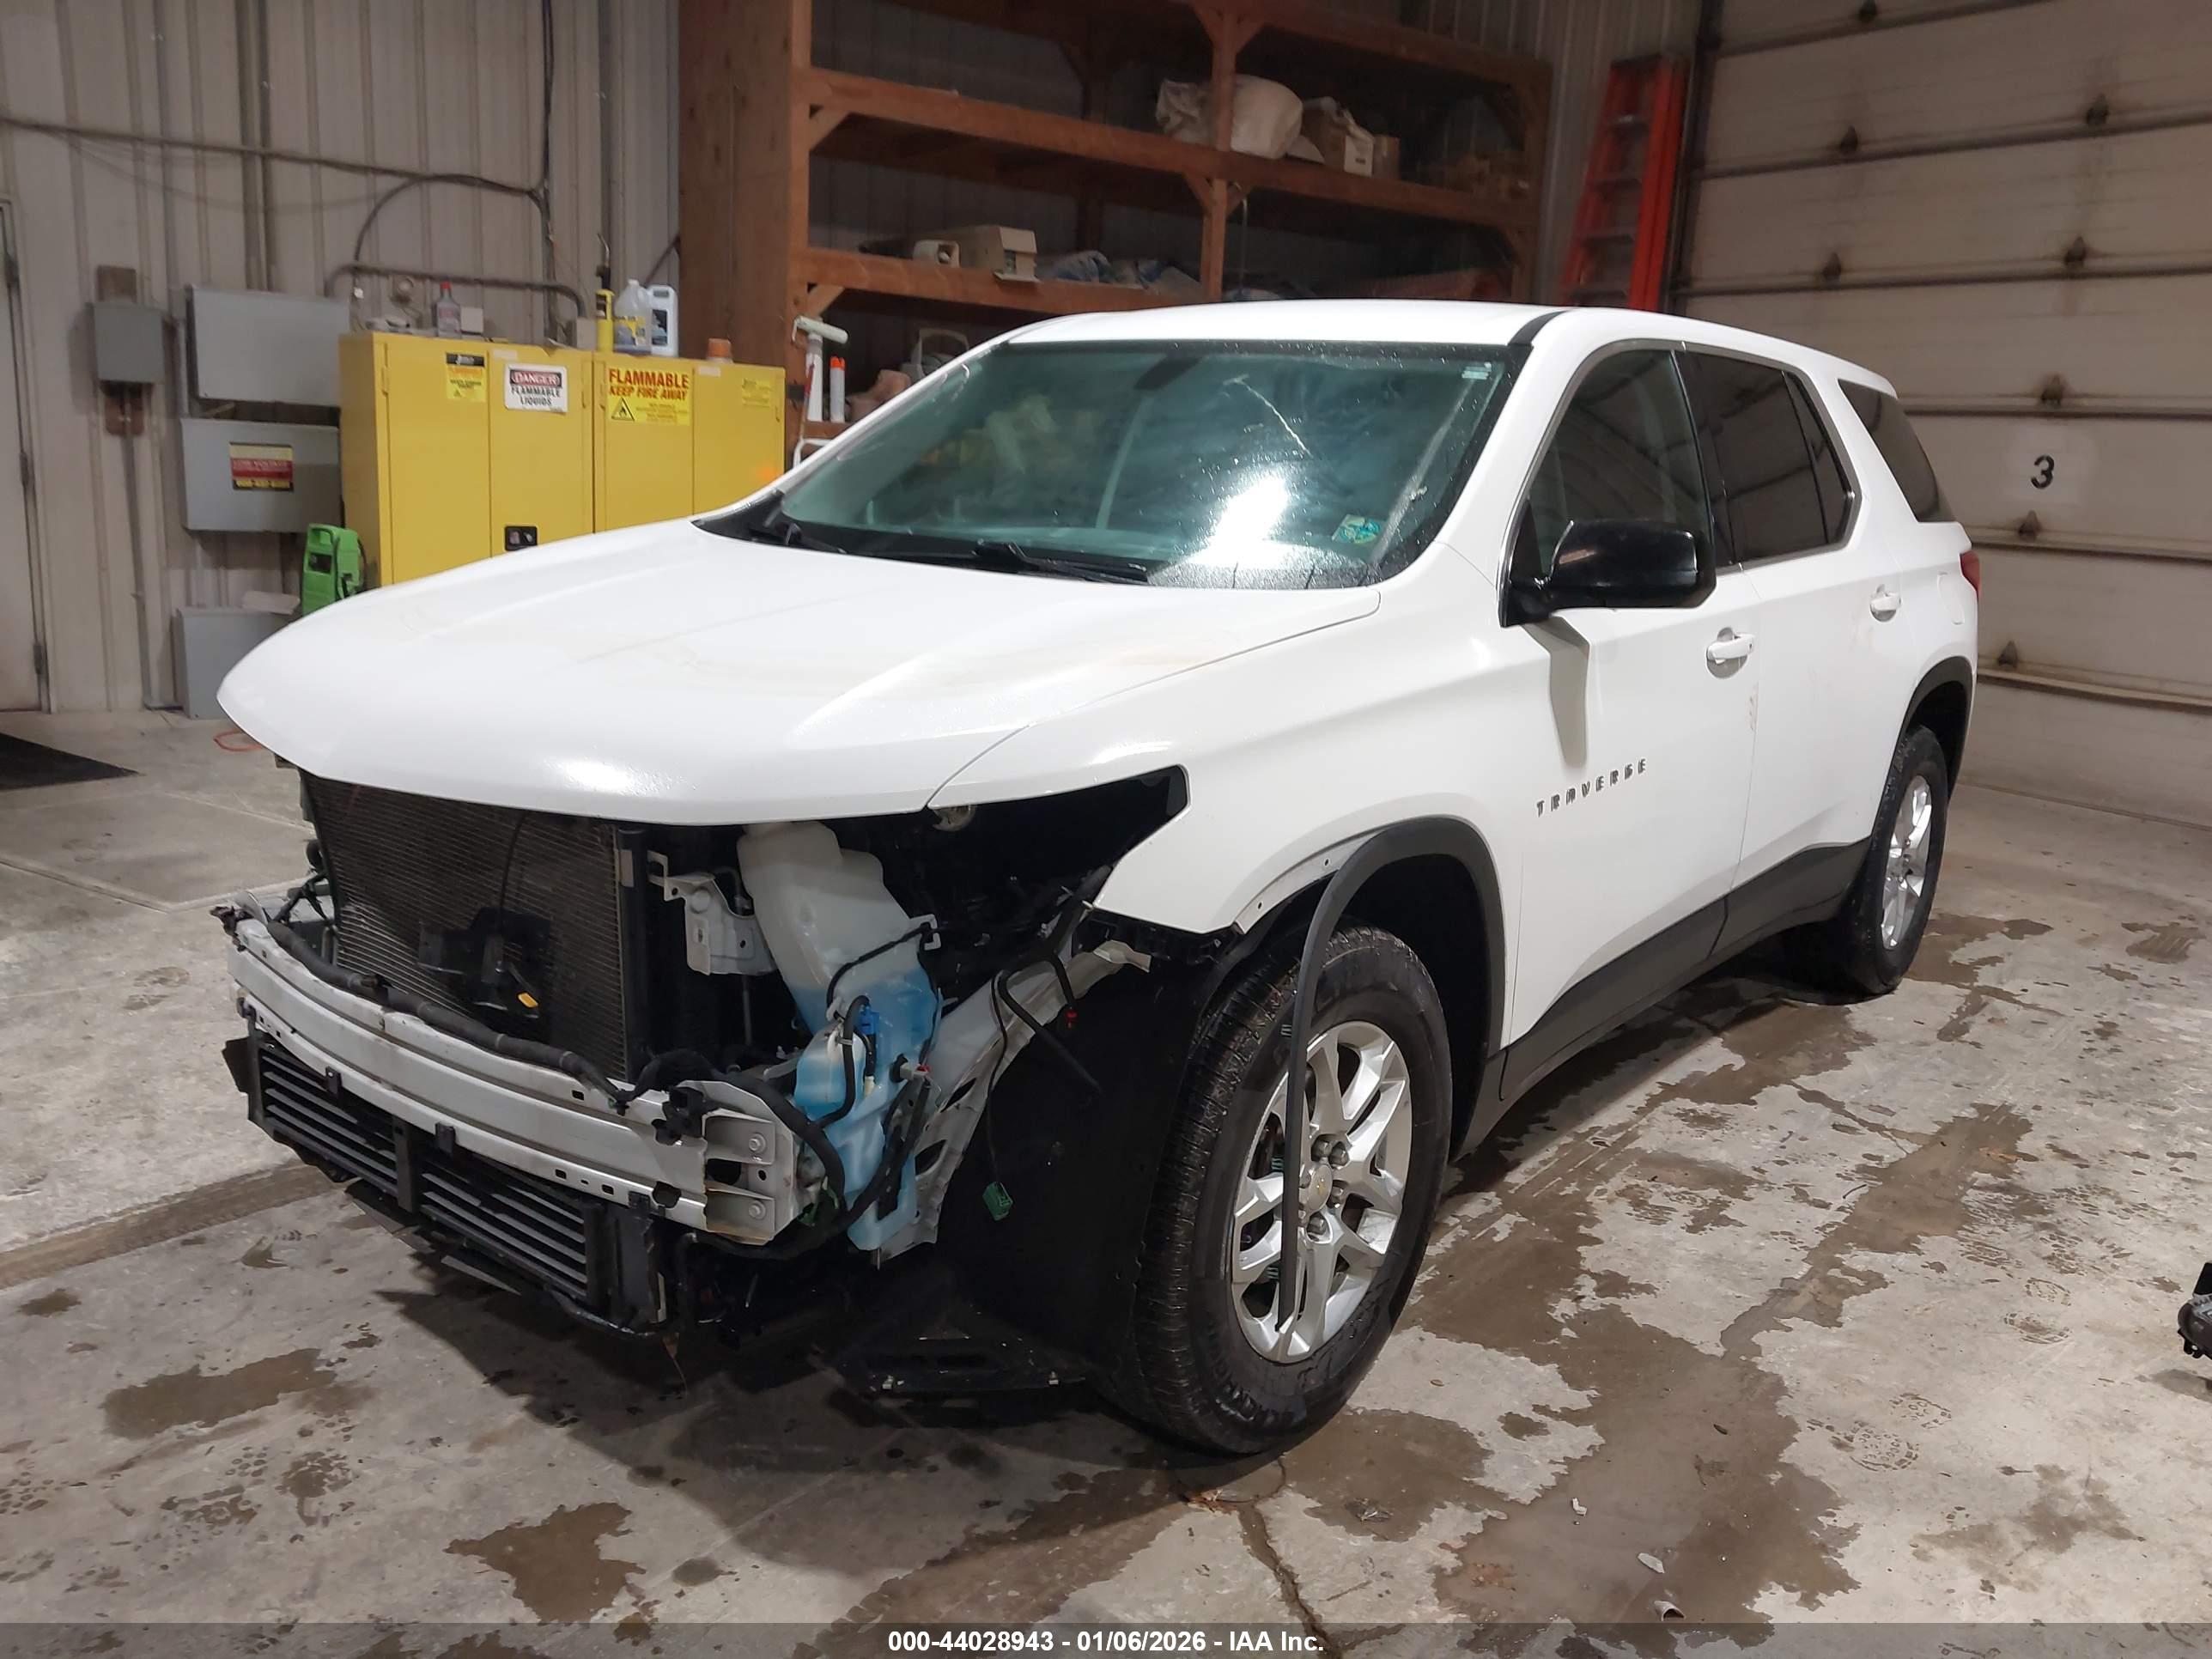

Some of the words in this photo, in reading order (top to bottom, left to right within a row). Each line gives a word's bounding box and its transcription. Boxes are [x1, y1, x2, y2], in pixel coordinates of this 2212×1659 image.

[514, 372, 558, 385] DANGER
[609, 369, 689, 389] FLAMMABLE
[511, 386, 561, 398] FLAMMABLE
[610, 386, 635, 397] KEEP
[637, 387, 659, 398] FIRE
[660, 389, 687, 400] AWAY
[520, 396, 552, 406] LIQUIDS
[2031, 455, 2054, 489] 3
[1536, 758, 1646, 817] TRAVERSE
